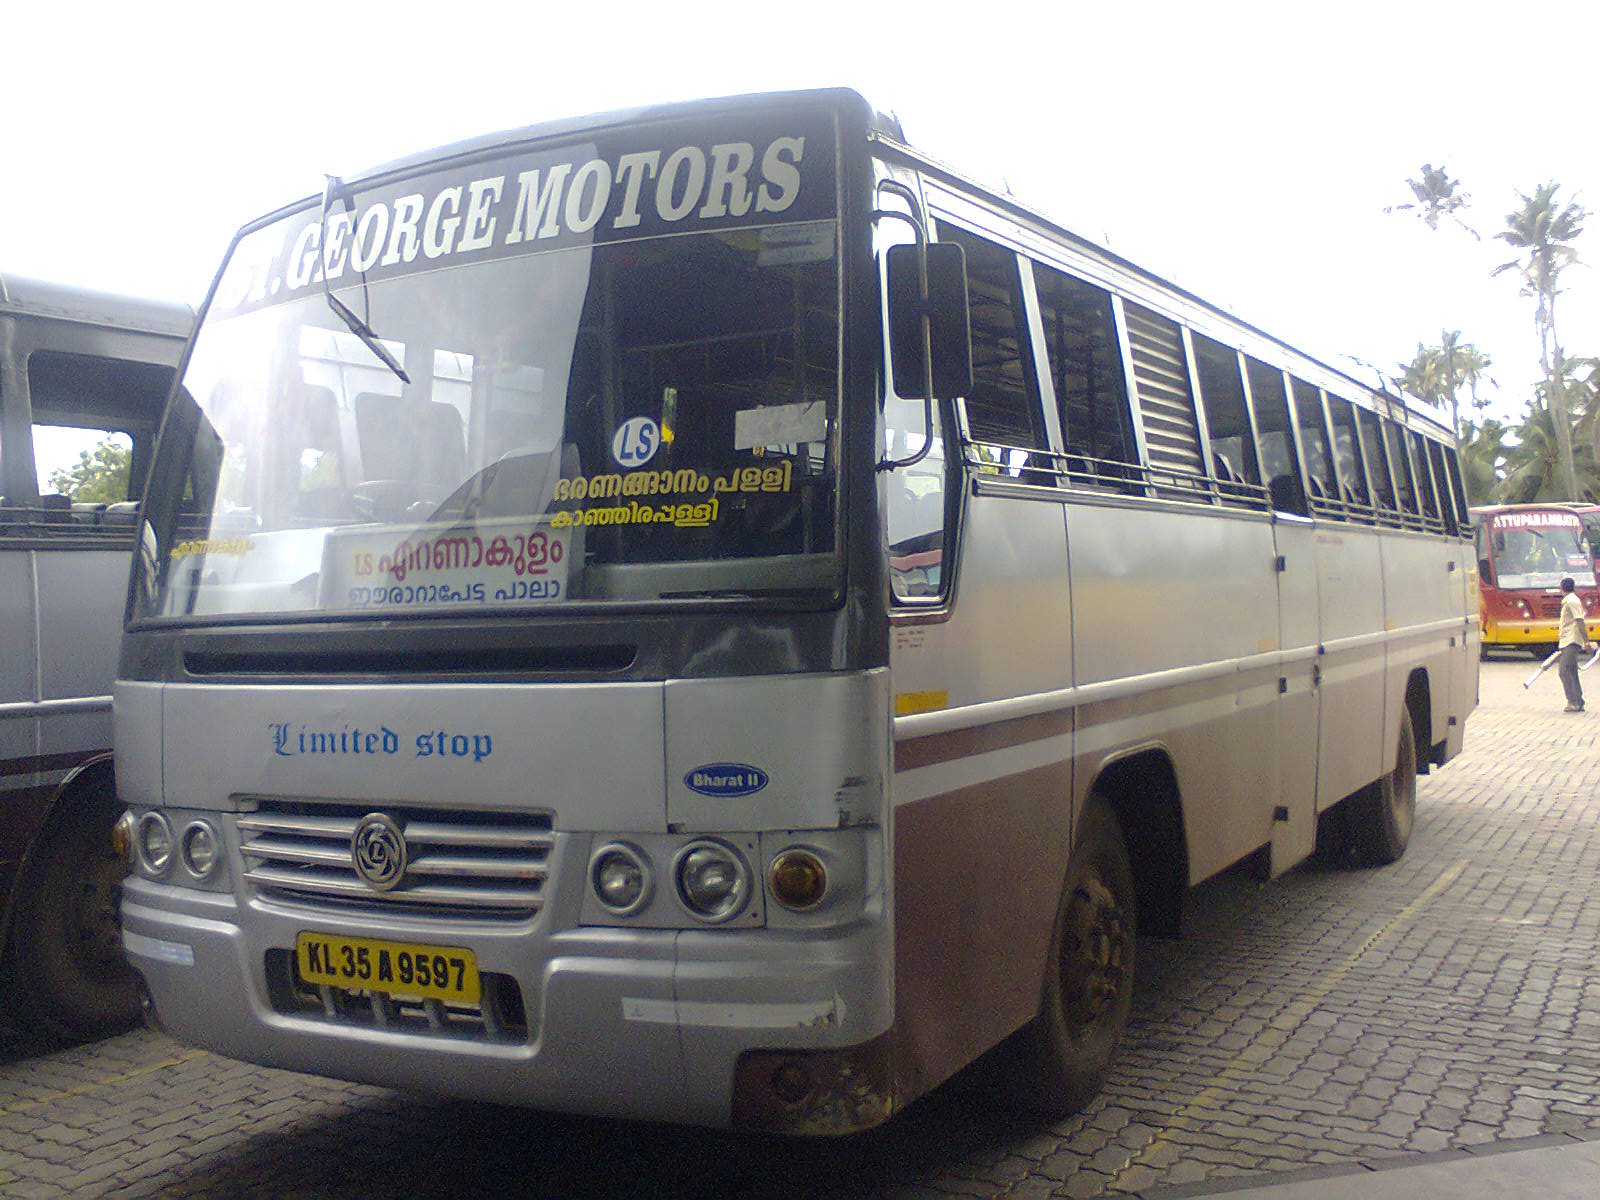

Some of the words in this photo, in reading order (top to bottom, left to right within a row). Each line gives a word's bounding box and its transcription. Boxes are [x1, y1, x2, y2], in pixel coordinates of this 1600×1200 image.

[286, 175, 506, 290] GEORGE
[505, 136, 805, 246] MOTORS
[619, 422, 654, 461] LS
[495, 579, 561, 601] പാലാ
[268, 722, 399, 756] Limited
[415, 728, 493, 763] stop
[692, 772, 743, 787] Bharat
